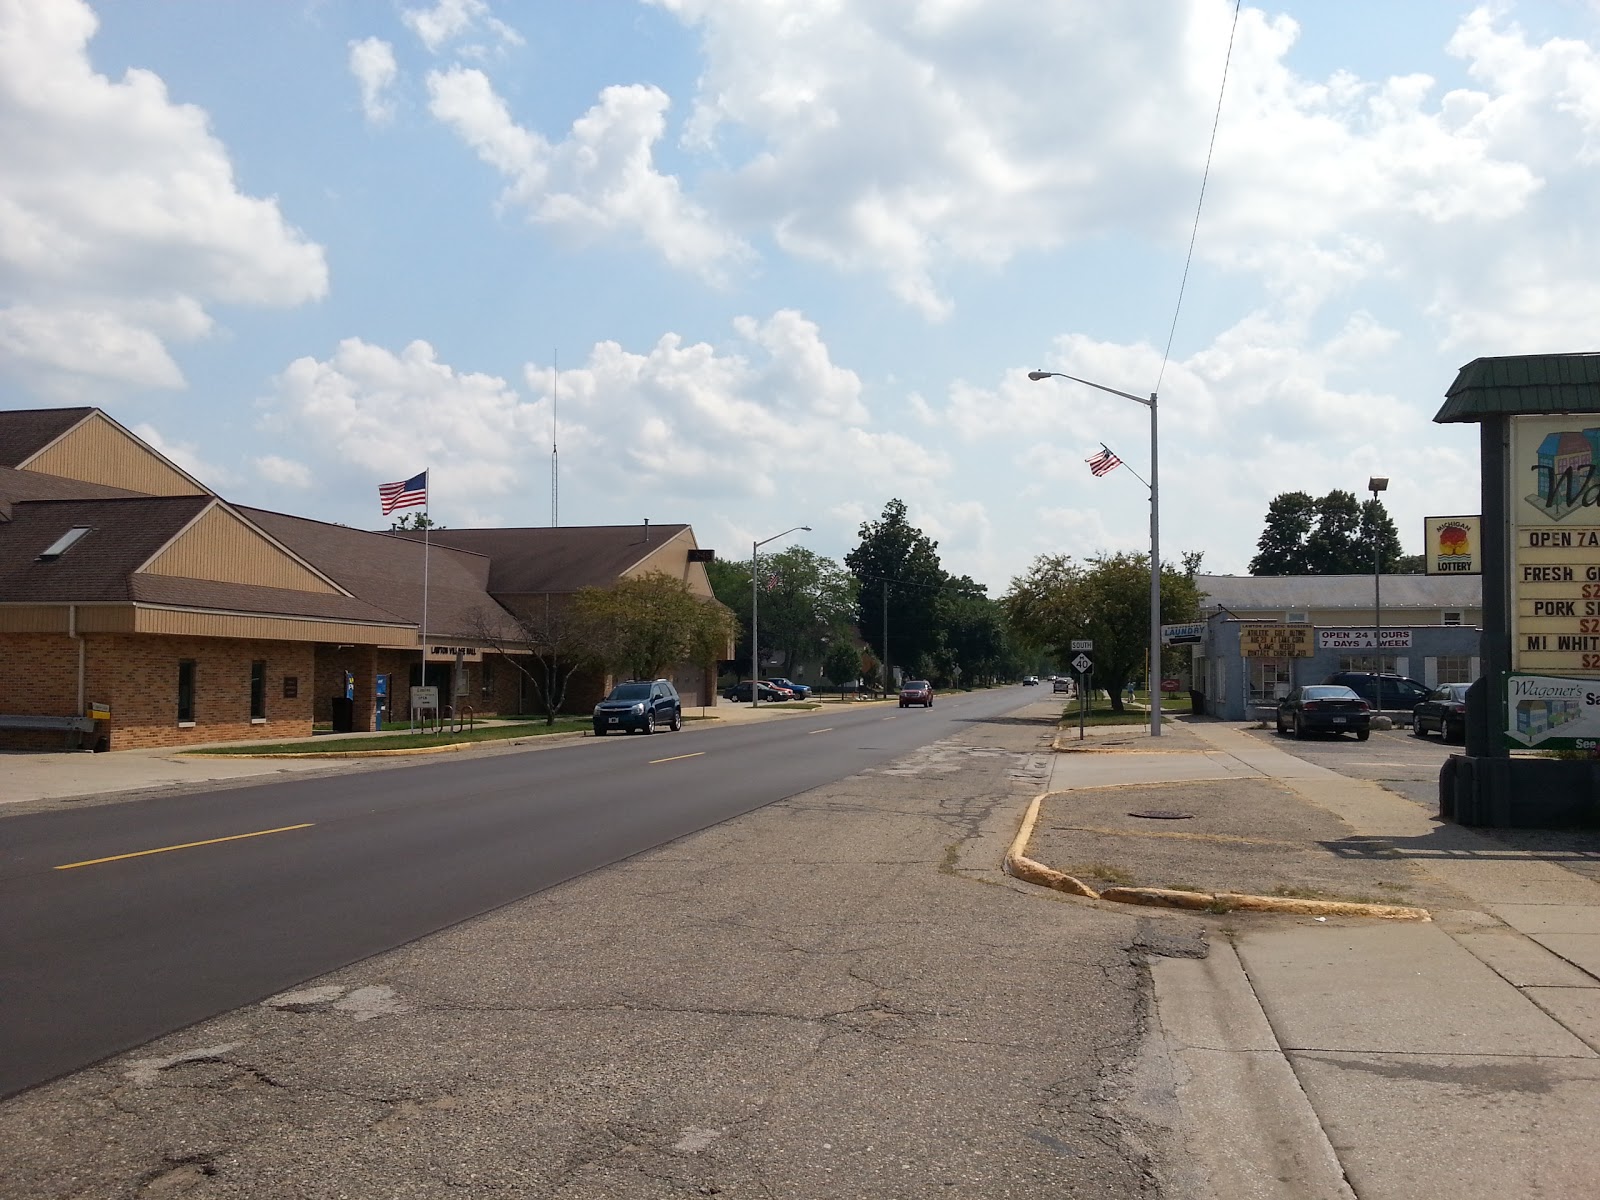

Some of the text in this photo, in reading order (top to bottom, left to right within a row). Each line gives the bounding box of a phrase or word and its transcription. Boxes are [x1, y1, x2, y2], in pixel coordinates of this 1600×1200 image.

[1436, 522, 1471, 532] MICHIGAN
[1530, 532, 1571, 546] OPEN
[1438, 562, 1472, 571] LOTTERY
[1524, 567, 1600, 580] FRESH G
[1534, 602, 1575, 615] PORK
[1165, 626, 1205, 636] LAUNDRY
[1528, 636, 1546, 650] MI
[1510, 680, 1583, 698] Wagoner's
[1576, 739, 1596, 748] See
